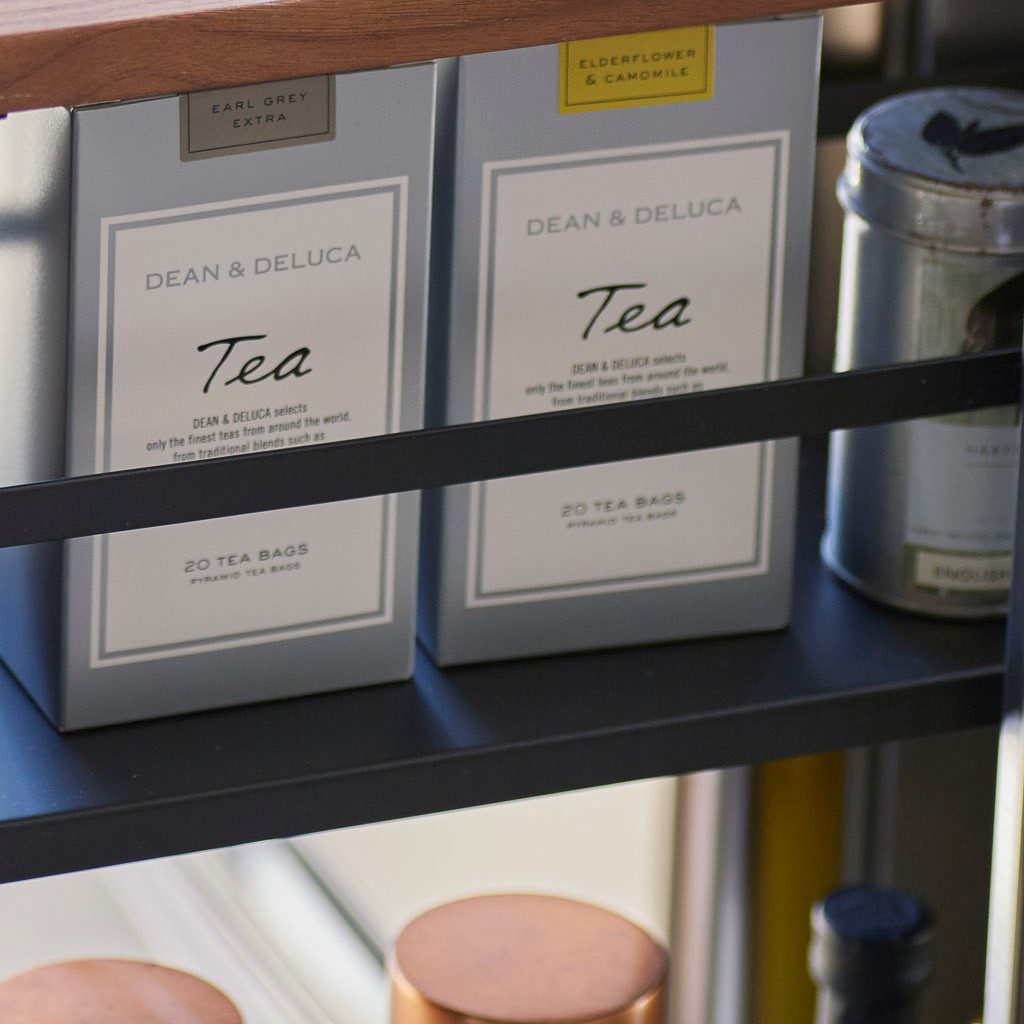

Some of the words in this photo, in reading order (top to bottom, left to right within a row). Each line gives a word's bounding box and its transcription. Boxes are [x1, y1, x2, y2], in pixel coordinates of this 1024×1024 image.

[578, 47, 697, 70] ELDERFLOWER
[584, 73, 598, 86] &
[605, 65, 690, 85] CAMOMILE
[211, 99, 255, 115] EARL
[263, 90, 309, 107] GREY
[232, 112, 288, 129] EXTRA
[526, 210, 601, 237] DEAN
[608, 209, 626, 227] &
[634, 196, 743, 225] DELUCA
[144, 263, 220, 291] DEAN
[228, 261, 246, 279] &
[254, 243, 362, 276] DELUCA
[576, 283, 693, 340] Tea
[196, 333, 313, 394] Tea
[572, 361, 599, 375] DEAN
[612, 355, 650, 371] DELUCA
[192, 415, 220, 430] DEAN
[222, 413, 229, 425] &
[233, 407, 272, 424] DELUCA
[274, 402, 308, 417] selects
[146, 438, 167, 452] only
[169, 436, 185, 448] the
[188, 431, 217, 446] finest
[219, 429, 240, 441] teas
[242, 426, 265, 437] from
[268, 418, 302, 433] around
[304, 416, 320, 428] the
[173, 451, 196, 462] from
[198, 441, 251, 459] traditional
[252, 436, 285, 450] blends
[287, 432, 311, 446] such
[314, 432, 325, 442] as
[560, 501, 588, 517] 20
[593, 497, 628, 513] TEA
[634, 490, 687, 509] BAGS
[184, 558, 211, 573] 20
[217, 553, 251, 567] TEA
[258, 543, 309, 562] BAGS
[189, 572, 241, 585] PYRAMID
[245, 568, 266, 578] TEA
[270, 562, 302, 574] BAGS
